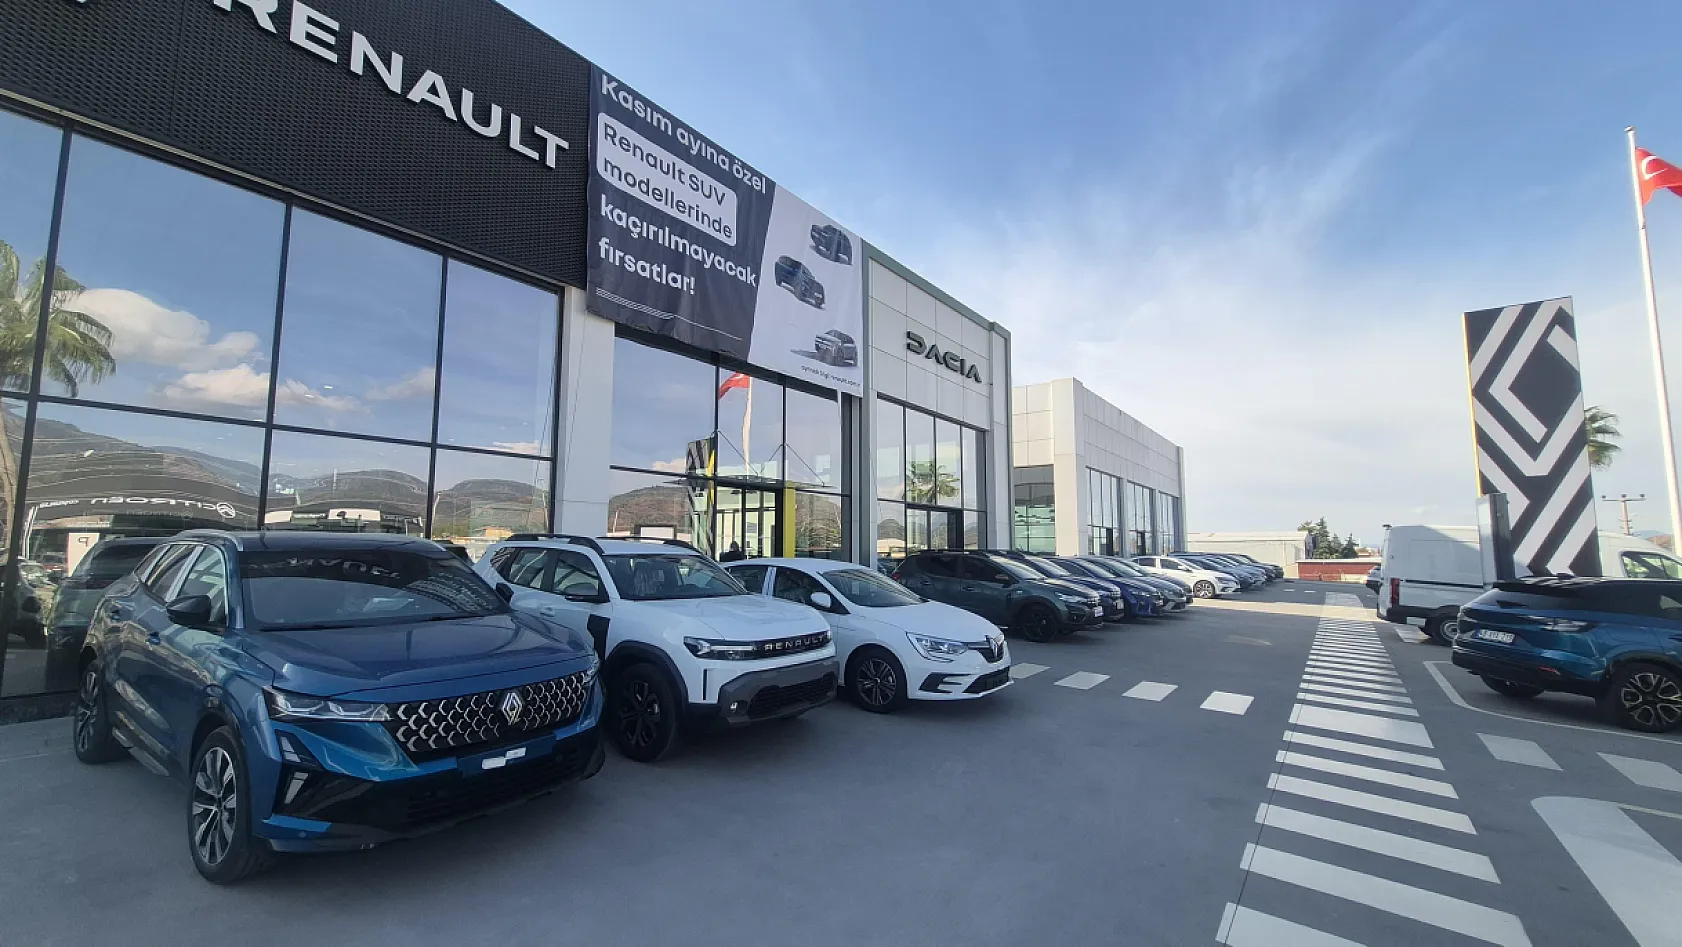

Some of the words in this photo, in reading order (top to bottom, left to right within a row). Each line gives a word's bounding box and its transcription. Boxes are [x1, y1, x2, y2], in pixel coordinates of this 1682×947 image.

[601, 74, 672, 136] Kasım
[676, 127, 730, 172] ayına
[732, 158, 766, 194] özel
[603, 122, 686, 186] Renault
[688, 173, 726, 207] SUV
[603, 157, 733, 238] modellerinde
[598, 236, 696, 295] fırsatlar!
[601, 193, 757, 287] kaçırılmayacak
[906, 330, 982, 384] DACIA
[764, 633, 825, 651] RENAULT
